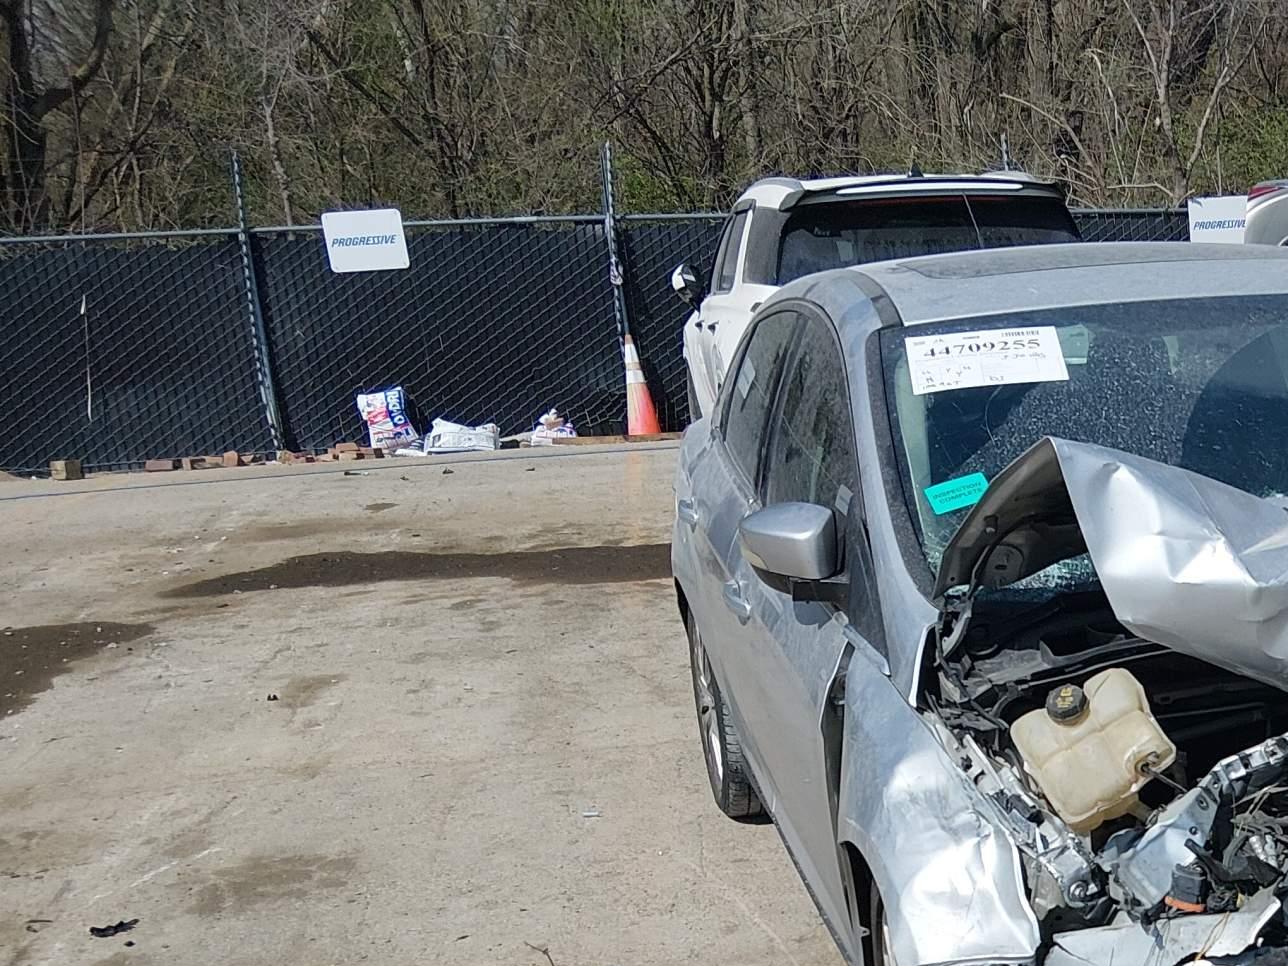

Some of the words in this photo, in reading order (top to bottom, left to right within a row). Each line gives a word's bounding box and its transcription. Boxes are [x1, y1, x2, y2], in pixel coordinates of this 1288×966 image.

[1193, 219, 1247, 231] PROGRESSIVE
[331, 234, 397, 248] PROGRESSIVE
[923, 338, 1041, 358] 44709255
[932, 481, 982, 501] INSPECTION
